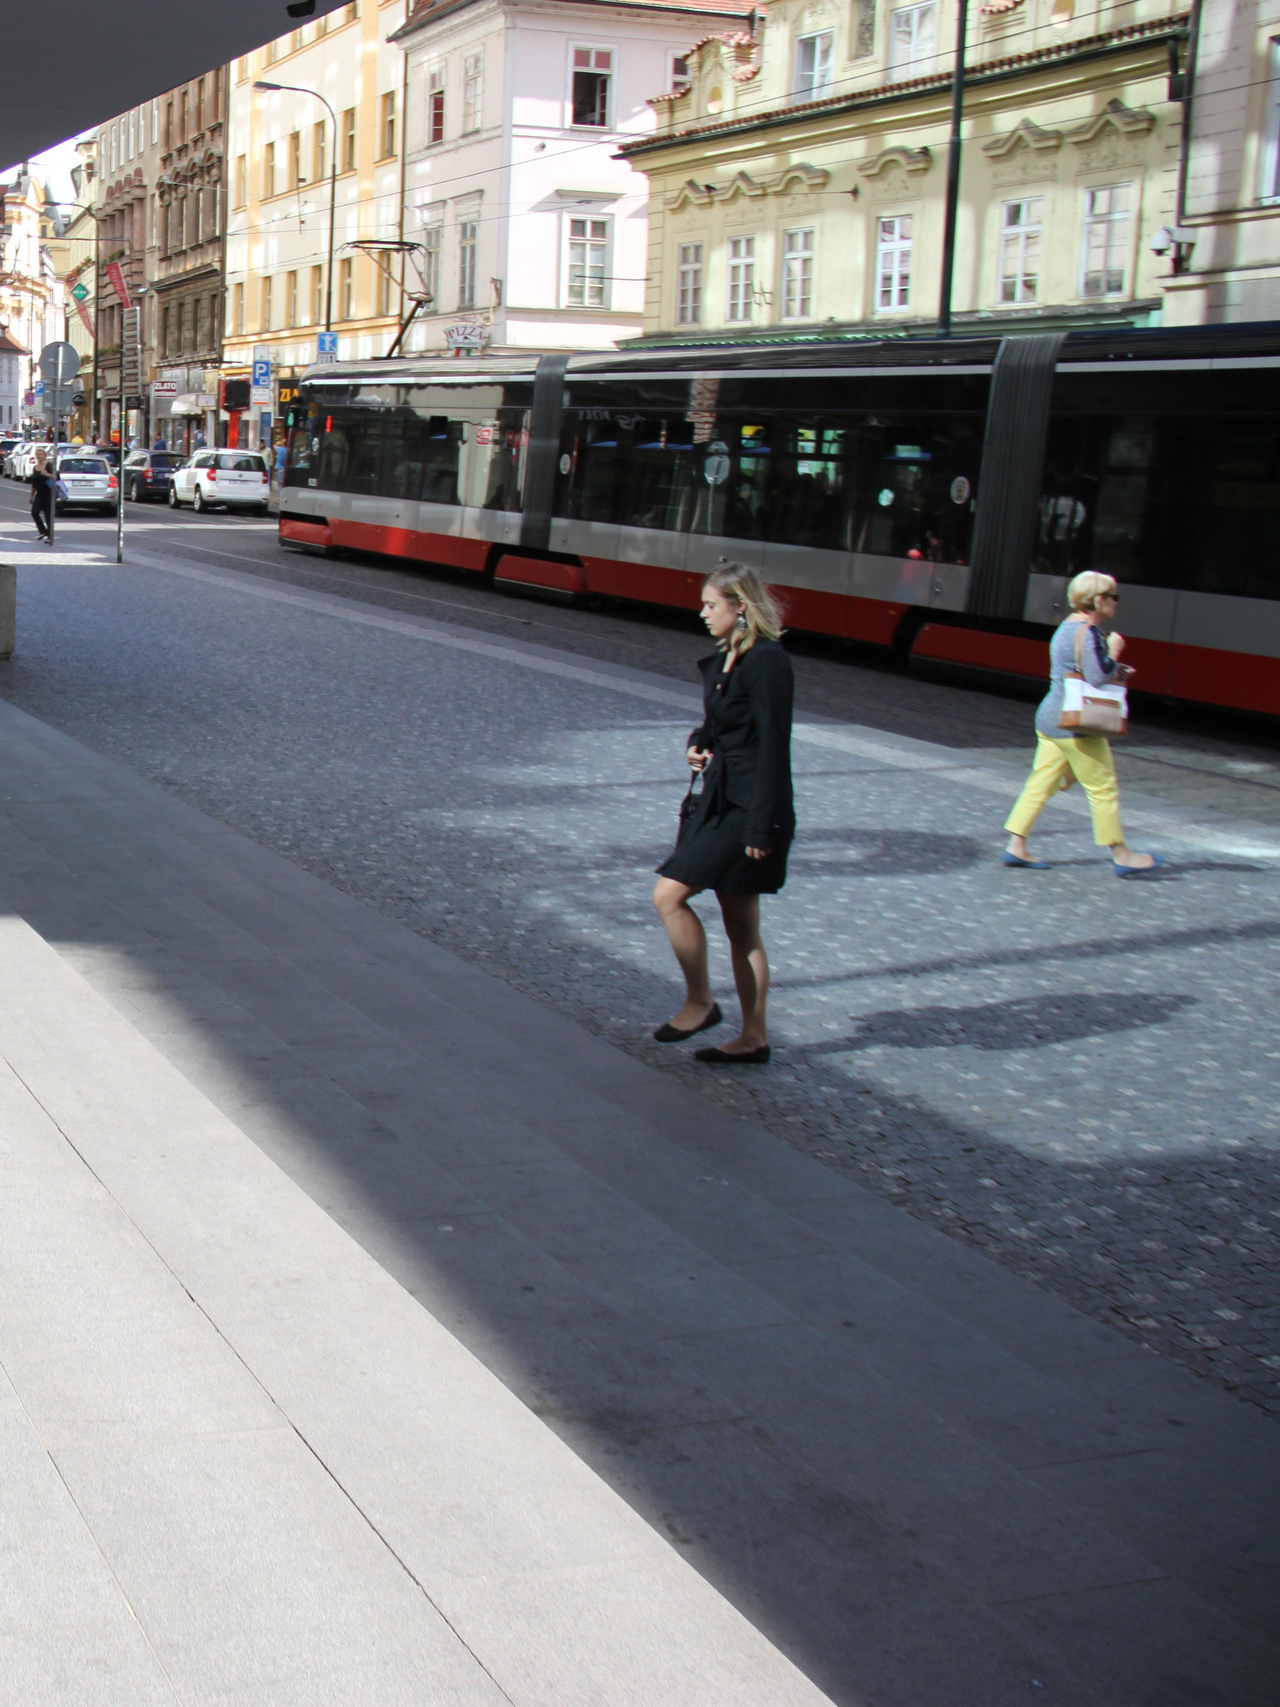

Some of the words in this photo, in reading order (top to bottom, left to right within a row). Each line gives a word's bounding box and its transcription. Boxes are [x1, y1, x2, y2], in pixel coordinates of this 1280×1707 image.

[447, 326, 483, 341] PIZZA
[255, 363, 267, 379] P
[154, 382, 177, 390] ZLATO
